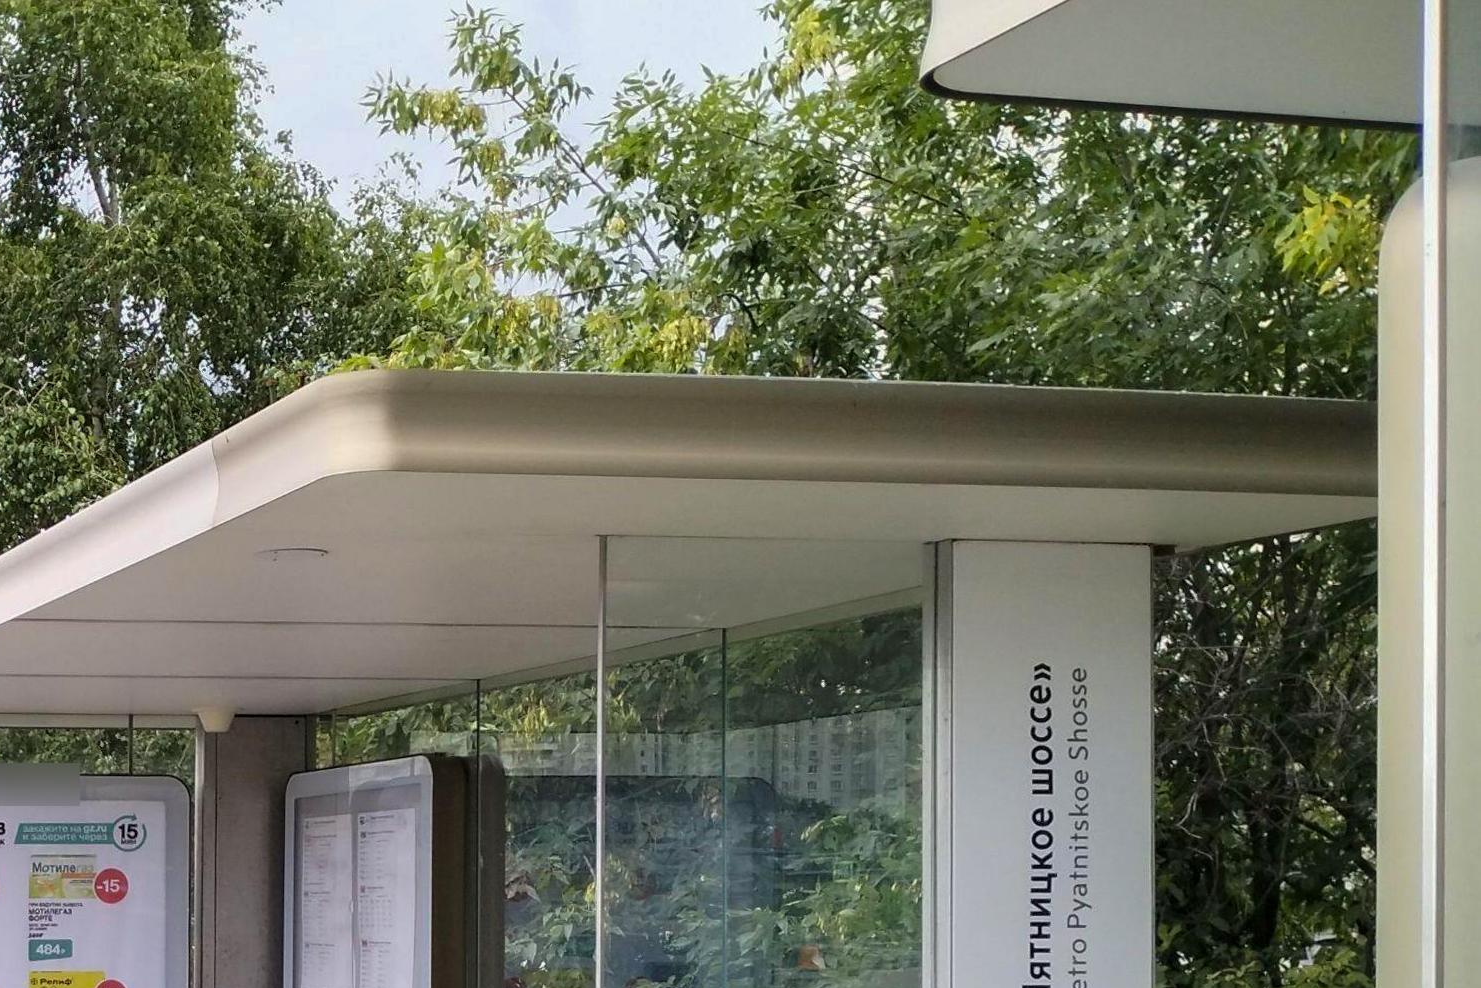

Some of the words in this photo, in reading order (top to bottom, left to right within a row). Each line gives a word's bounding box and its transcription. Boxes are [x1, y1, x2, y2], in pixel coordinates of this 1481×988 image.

[1030, 662, 1055, 795] шоссе»
[1068, 668, 1088, 760] Shosse
[118, 822, 138, 840] 15
[1068, 769, 1093, 929] Pyatnitskoe
[39, 978, 72, 986] Релиф
